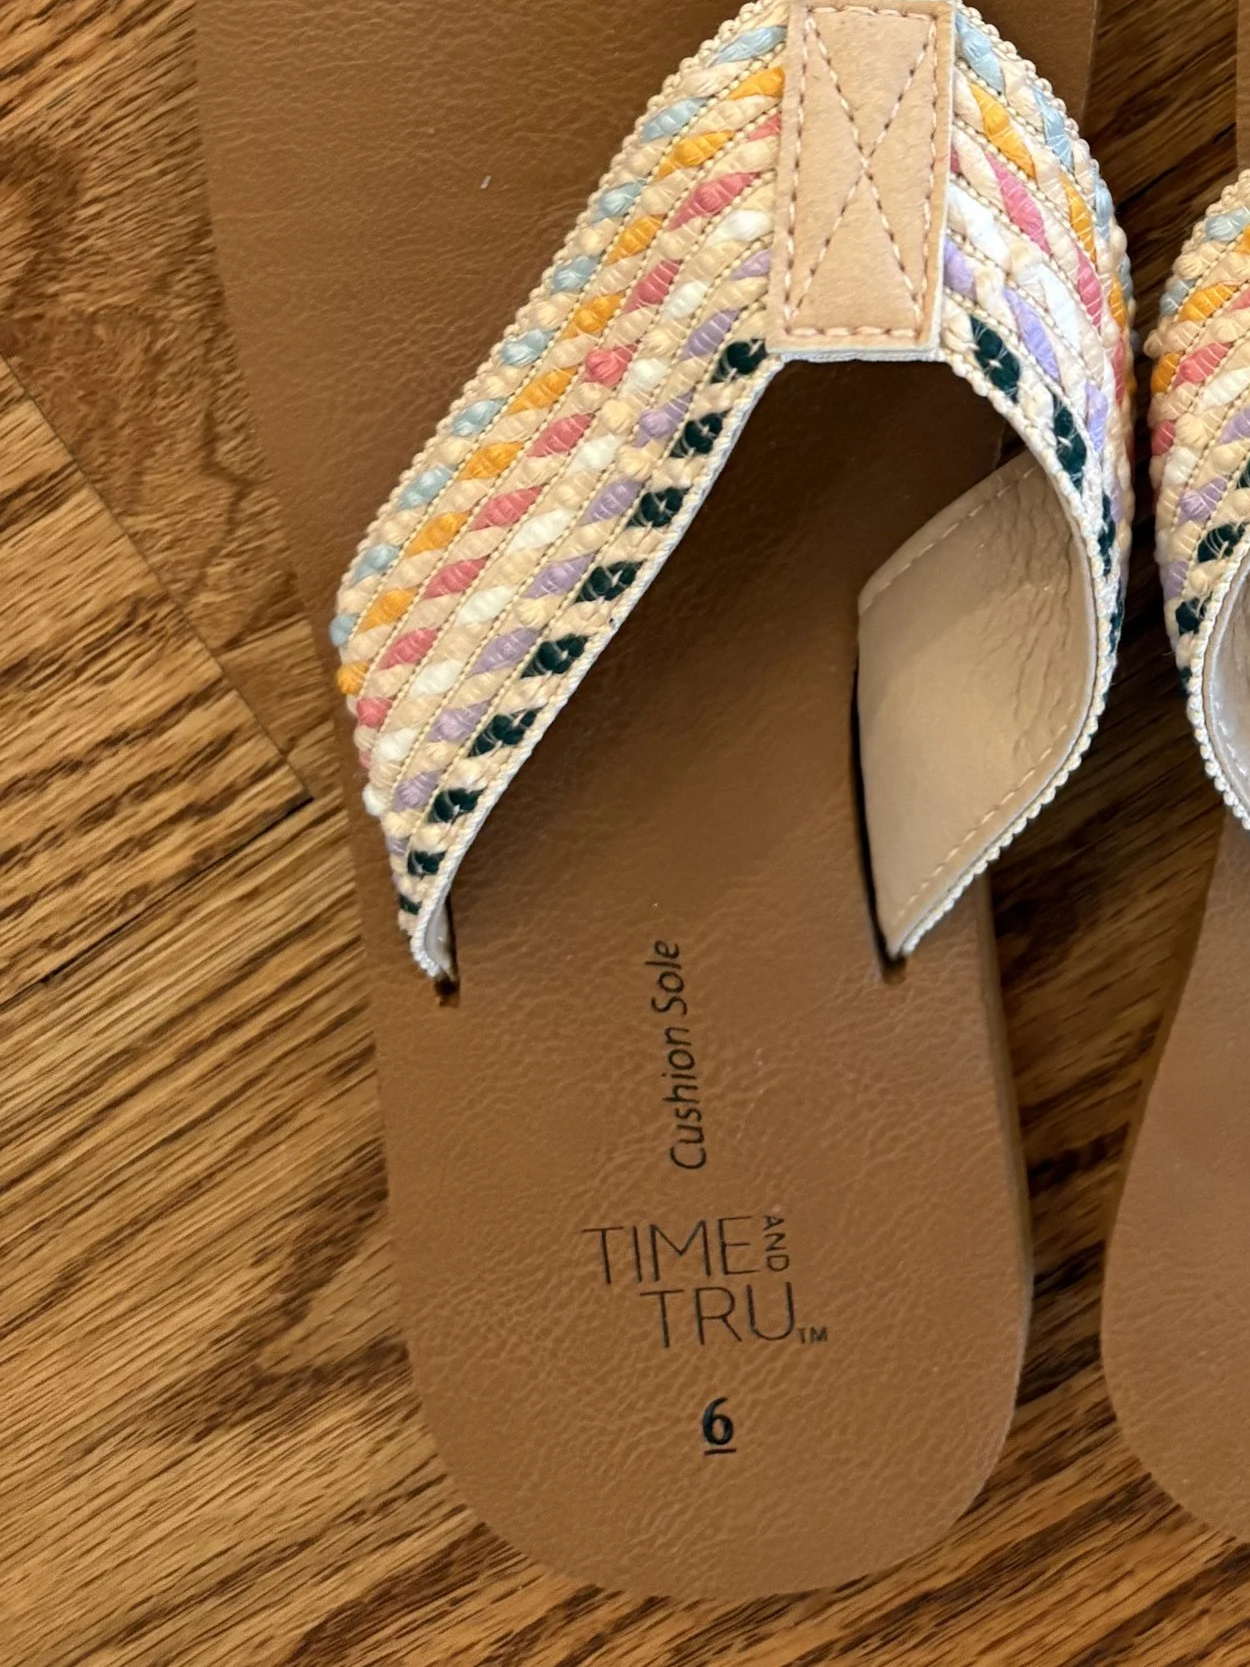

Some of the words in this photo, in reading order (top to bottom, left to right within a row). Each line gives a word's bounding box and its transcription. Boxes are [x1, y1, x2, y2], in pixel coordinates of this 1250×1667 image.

[645, 939, 689, 1016] Sole
[660, 1026, 707, 1170] Cushion
[581, 1215, 762, 1285] TIME
[763, 1215, 790, 1272] AND
[640, 1282, 796, 1349] TRU
[702, 1396, 735, 1449] 6
